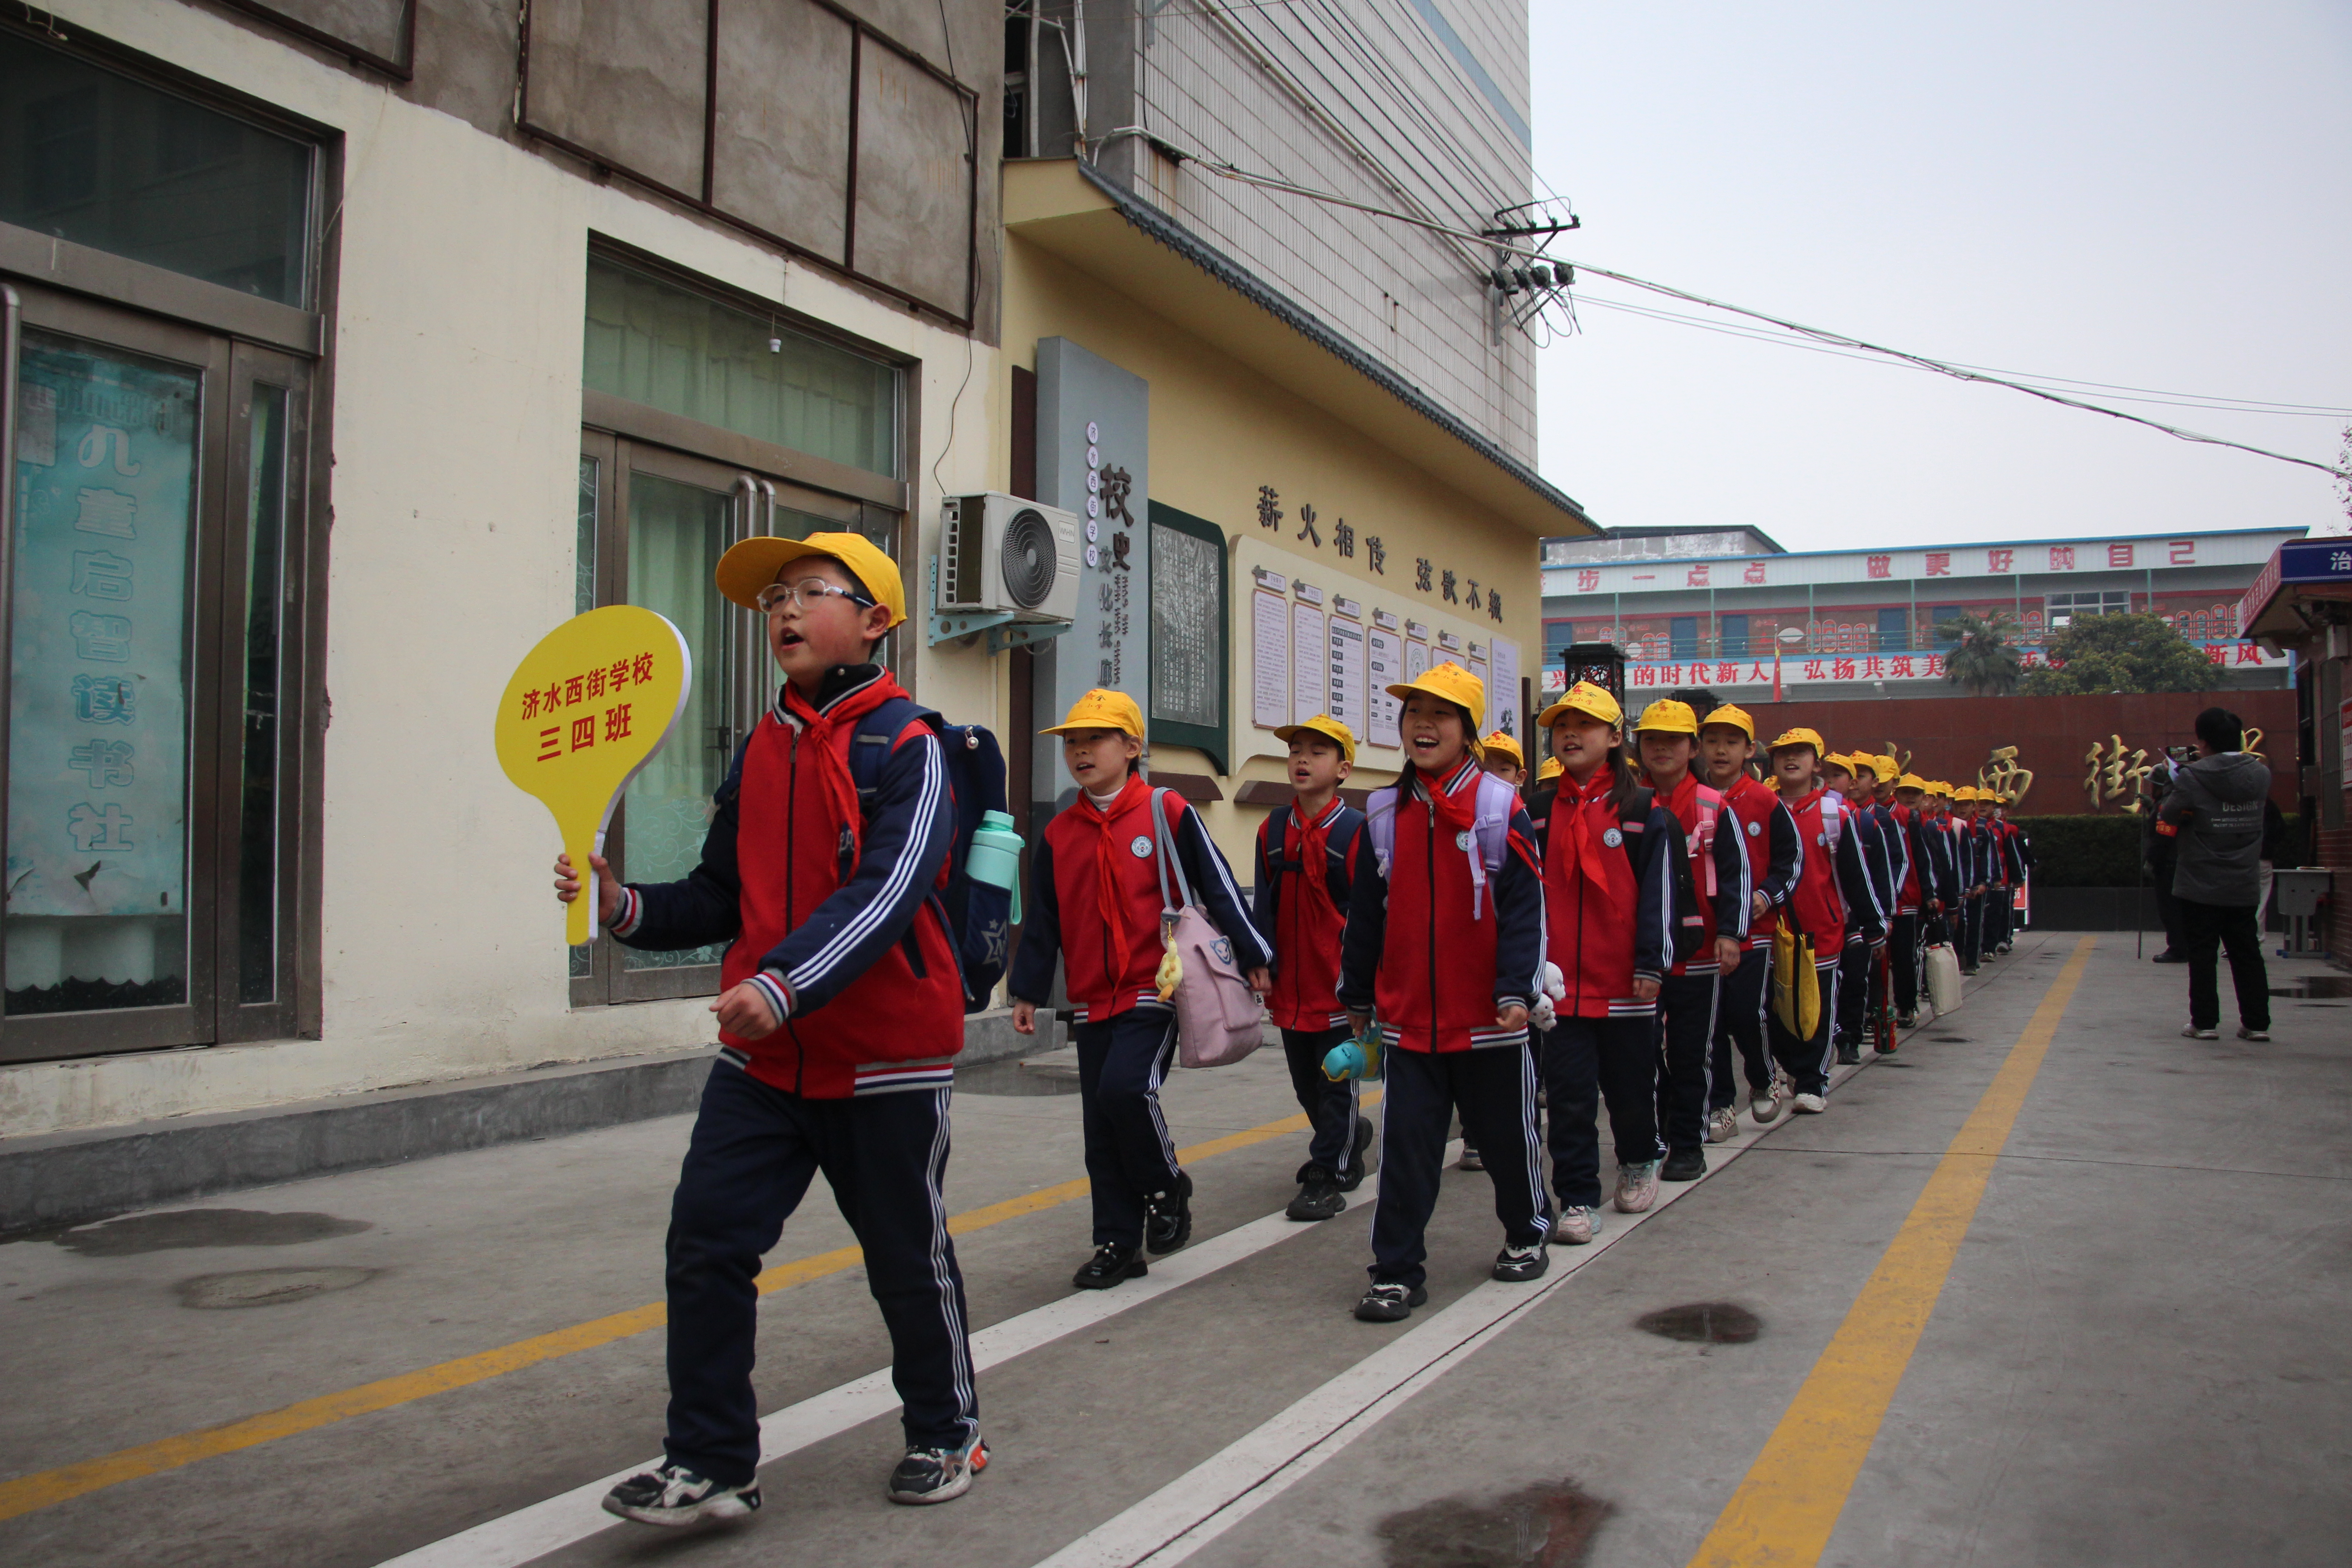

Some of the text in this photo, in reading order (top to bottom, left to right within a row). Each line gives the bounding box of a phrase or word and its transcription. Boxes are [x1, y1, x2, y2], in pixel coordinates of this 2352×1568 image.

[1099, 463, 1134, 571] 校史
[1257, 485, 1503, 623] 薪火相传 弦歌不辍
[1541, 541, 2196, 593] 步一点点 做更好的自己
[2330, 551, 2352, 570] 治
[1098, 545, 1113, 687] 文化长廊
[522, 652, 653, 720] 济水西街学校
[537, 703, 632, 762] 三四班
[2223, 800, 2259, 812] DESIGN
